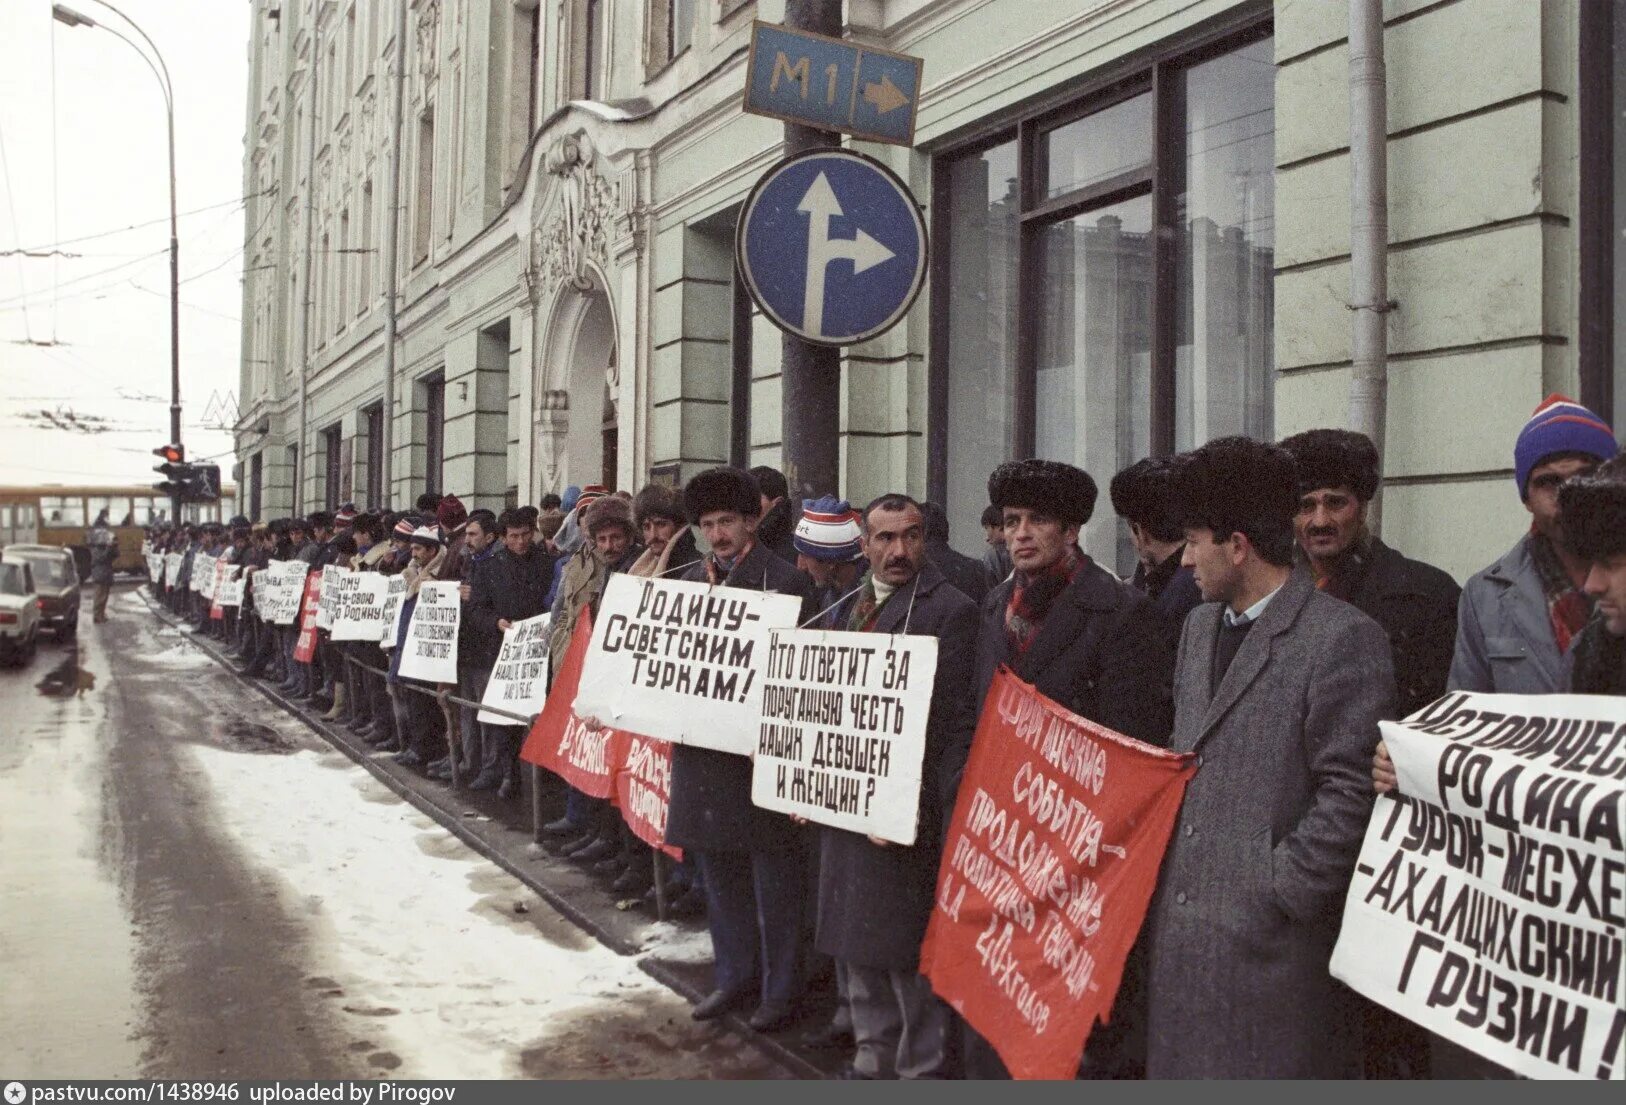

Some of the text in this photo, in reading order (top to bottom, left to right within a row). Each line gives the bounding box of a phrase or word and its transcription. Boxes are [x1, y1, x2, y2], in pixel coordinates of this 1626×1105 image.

[602, 613, 755, 679] СОВЕТСКИМ
[767, 632, 911, 691] КТО ОТВЕТИТ ЗА
[631, 652, 757, 704] ТУРКАМ!
[762, 684, 905, 735] ПОРУГАННУЮ ЧЕСТЬ
[1398, 691, 1626, 780] ИСТОРИЧЕС
[758, 723, 891, 778] НАШИХ ДЕВУШЕК
[776, 764, 787, 799] И
[1438, 742, 1625, 852] РОДИНА
